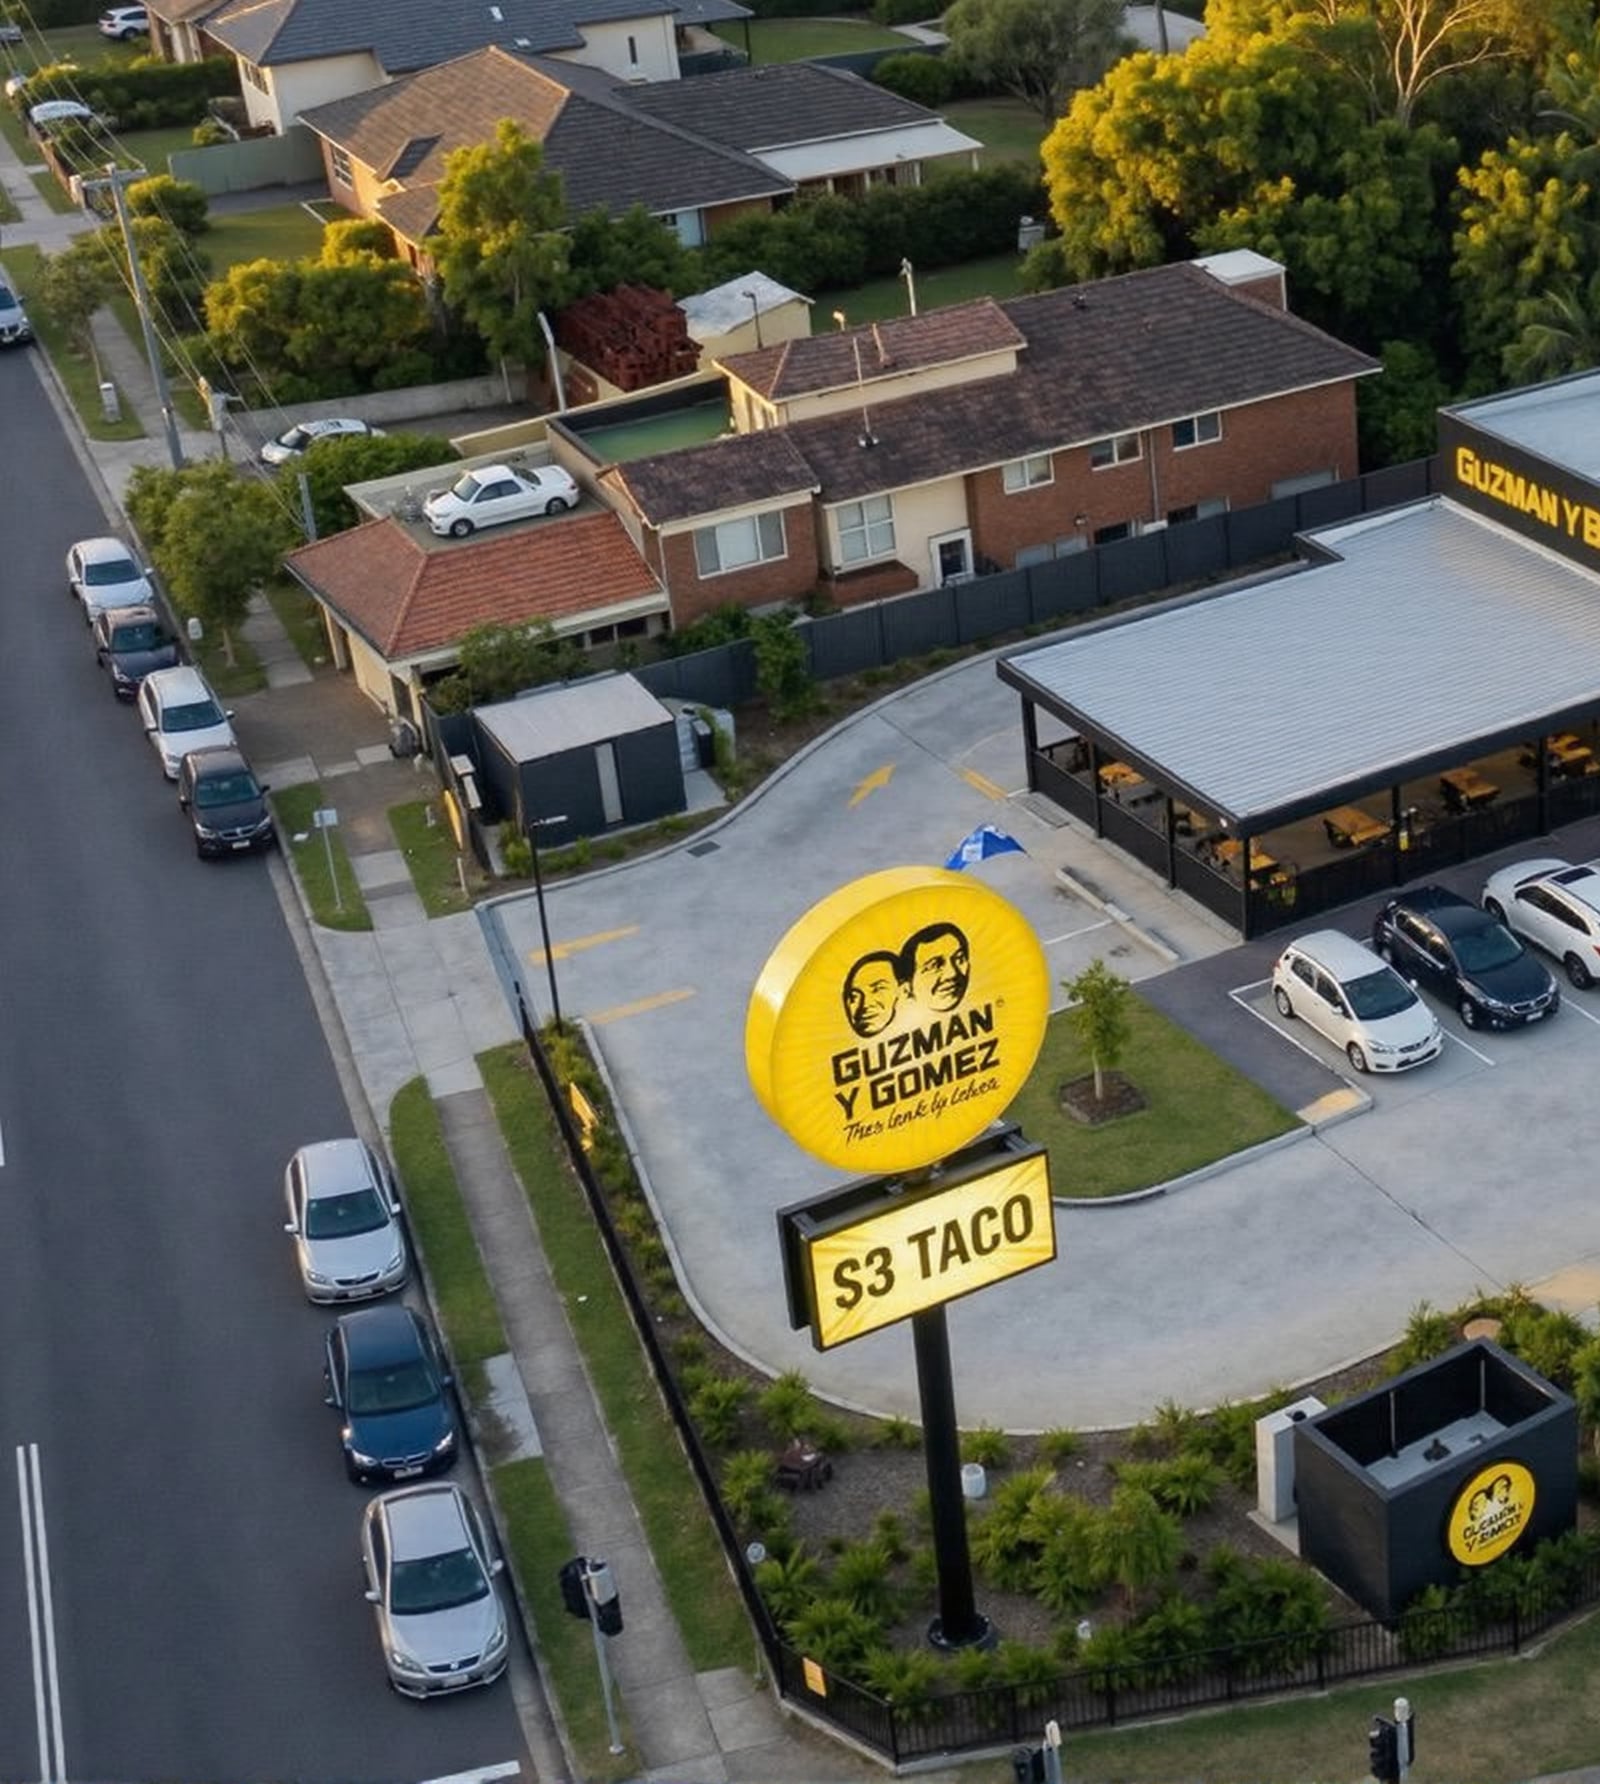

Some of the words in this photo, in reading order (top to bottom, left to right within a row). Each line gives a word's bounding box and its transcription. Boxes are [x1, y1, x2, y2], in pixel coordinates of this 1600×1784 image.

[1456, 447, 1558, 527] GUZMAN
[1563, 498, 1581, 538] Y
[832, 1003, 994, 1087] GUZMAN
[835, 1086, 860, 1121] Y
[869, 1038, 1000, 1111] GOMEZ
[907, 1193, 1034, 1280] TACO
